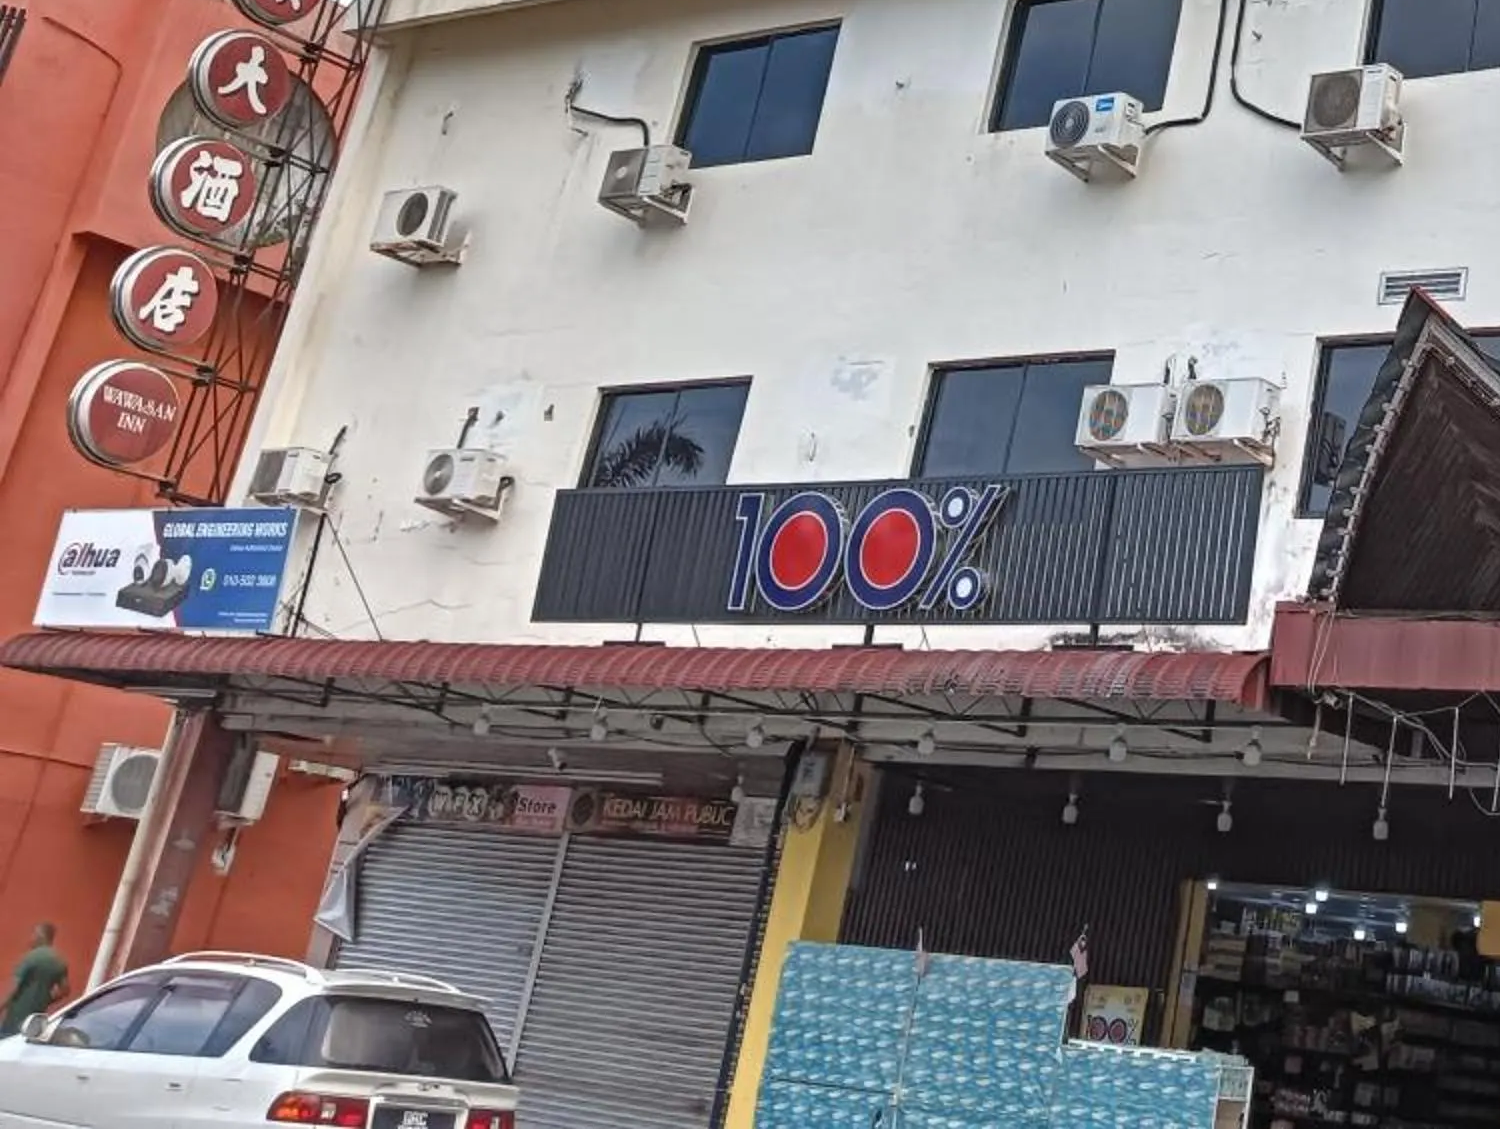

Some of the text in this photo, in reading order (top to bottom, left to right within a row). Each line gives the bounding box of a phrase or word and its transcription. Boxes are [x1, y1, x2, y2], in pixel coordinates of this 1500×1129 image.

[103, 384, 177, 423] WAWASAN
[117, 412, 148, 434] INN
[727, 484, 1004, 612] 100%
[516, 795, 557, 815] Store
[602, 797, 647, 819] KEDAI
